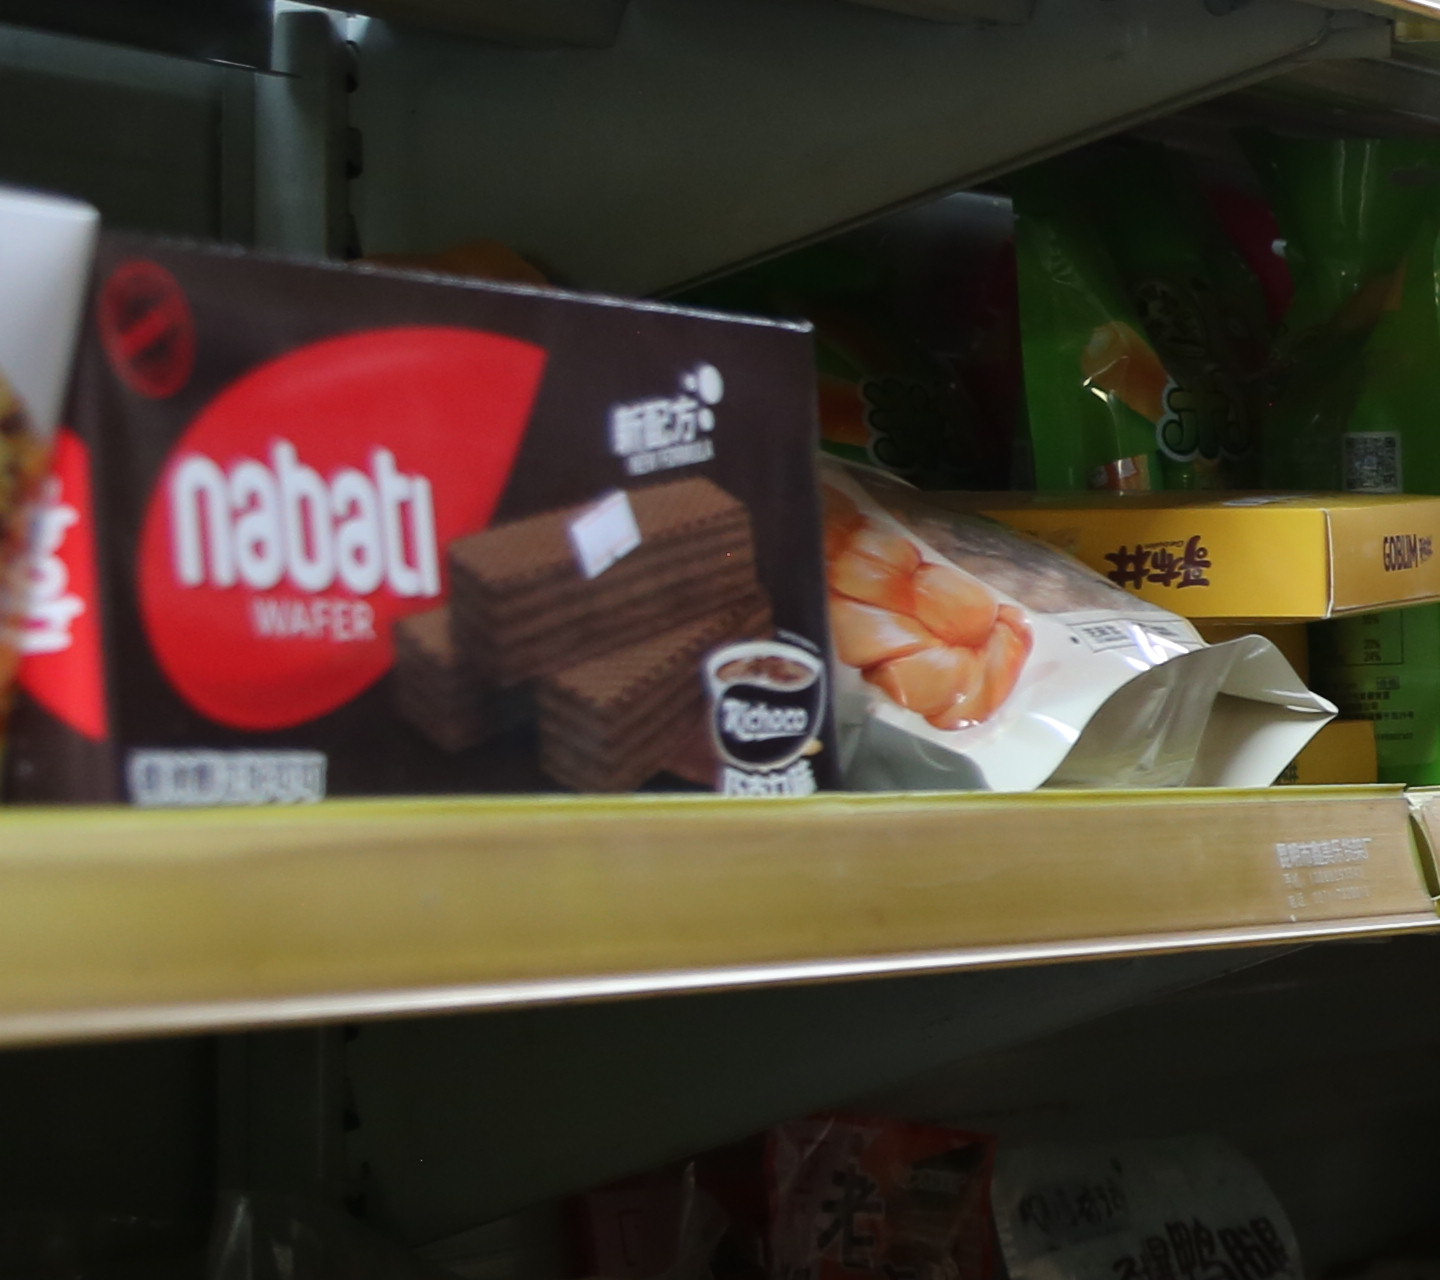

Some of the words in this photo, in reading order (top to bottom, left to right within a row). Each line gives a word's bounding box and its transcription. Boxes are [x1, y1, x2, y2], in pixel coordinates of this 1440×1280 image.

[611, 396, 698, 458] 新配方
[168, 436, 441, 599] nabati
[1104, 534, 1213, 591] 哥布林
[252, 598, 374, 642] WAFER
[724, 696, 808, 740] Richoco
